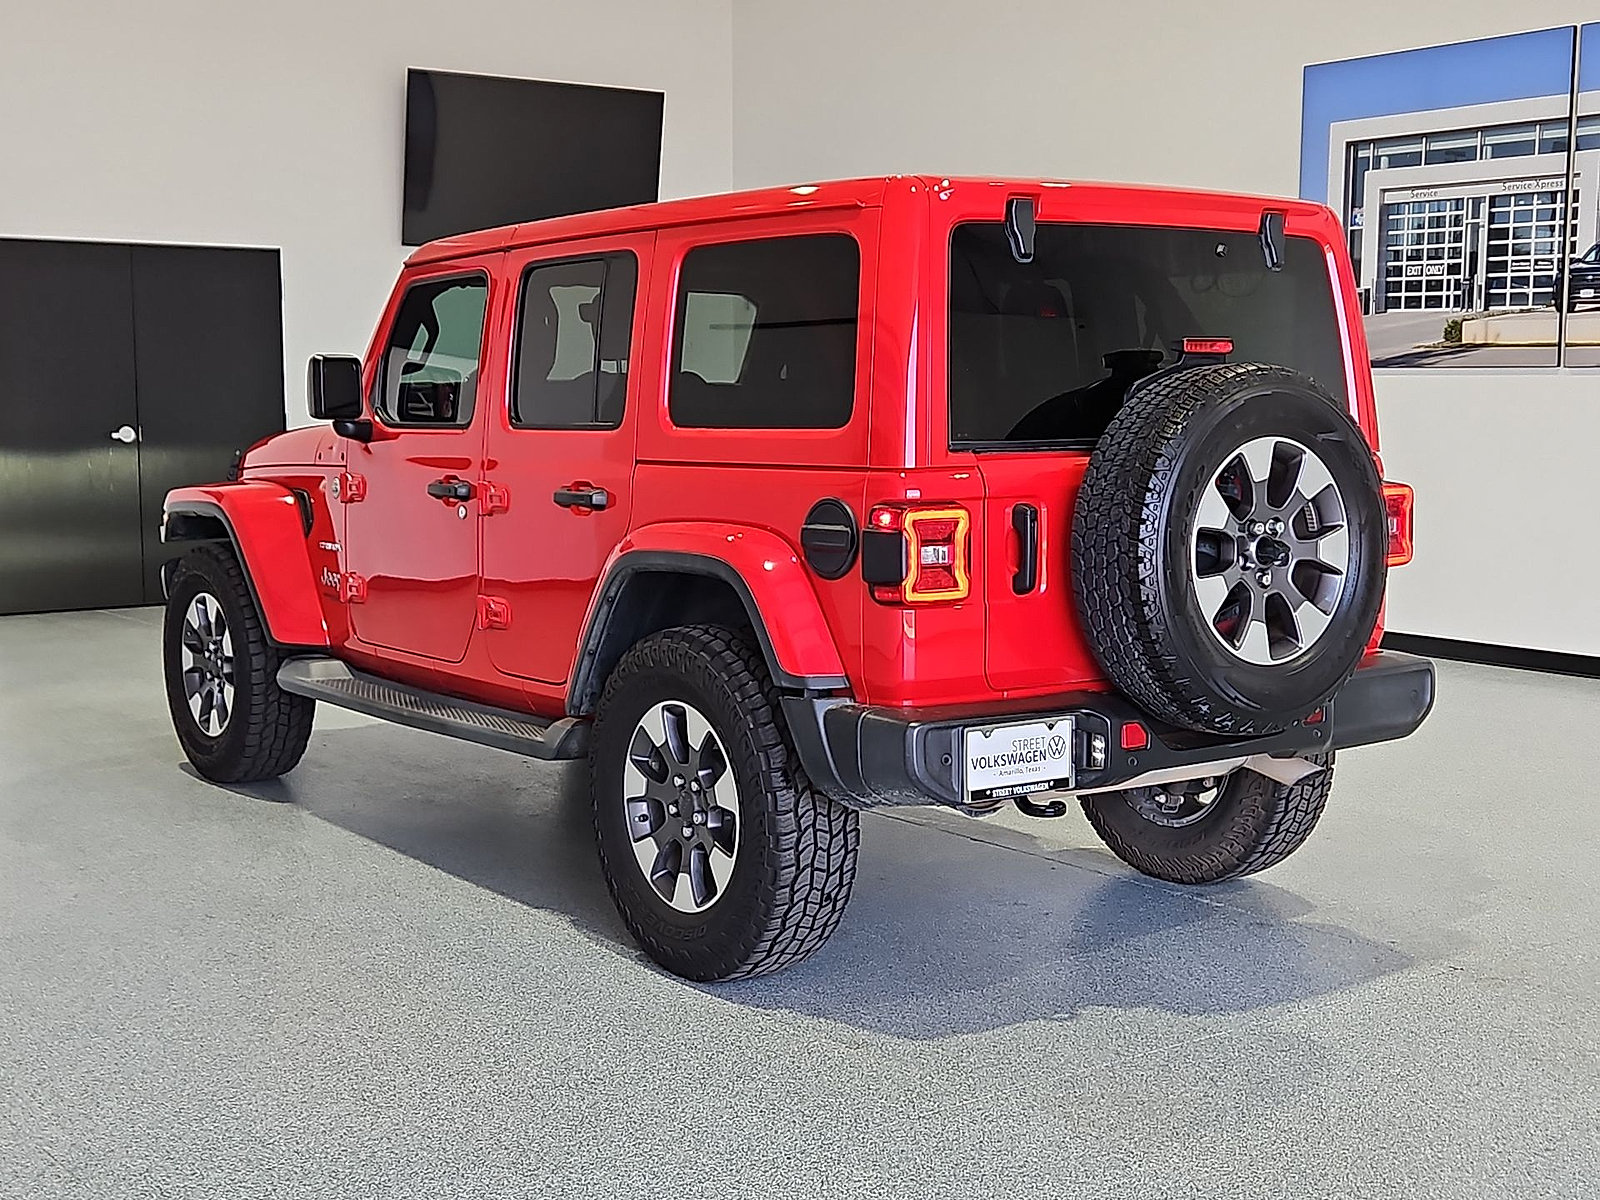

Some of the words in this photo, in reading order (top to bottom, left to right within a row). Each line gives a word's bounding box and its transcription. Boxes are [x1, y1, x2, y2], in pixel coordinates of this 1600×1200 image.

[1502, 182, 1531, 191] Service
[1534, 180, 1564, 190] Xpress
[1410, 189, 1438, 198] Service
[1407, 265, 1422, 276] EXIT
[1426, 265, 1445, 276] ONLY
[1012, 736, 1046, 752] STREET
[971, 749, 1047, 770] VOLKSWAGEN
[1026, 766, 1041, 774] Texas
